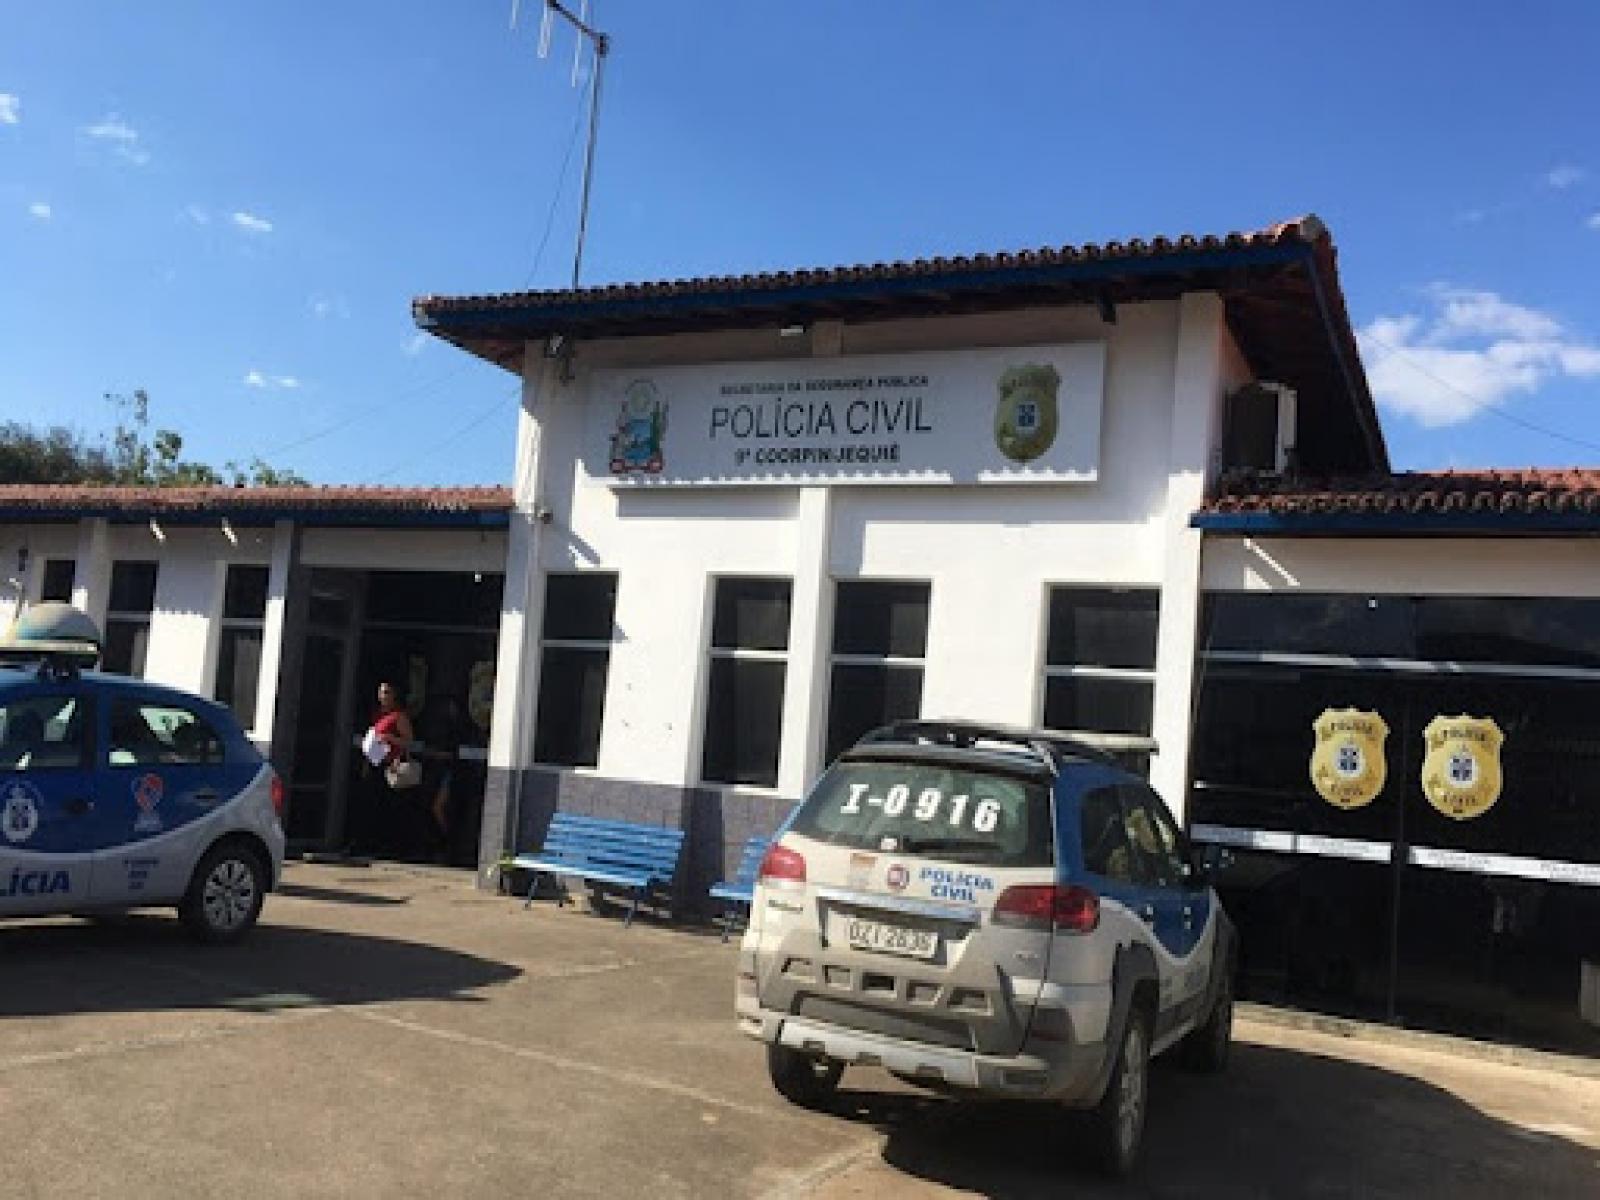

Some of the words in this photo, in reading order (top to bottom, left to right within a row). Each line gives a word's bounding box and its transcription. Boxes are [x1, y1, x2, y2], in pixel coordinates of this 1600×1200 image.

[709, 397, 836, 438] POLÍCIA
[847, 398, 932, 434] CIVIL
[840, 784, 1000, 832] I-0916
[0, 865, 70, 897] ÍCIA
